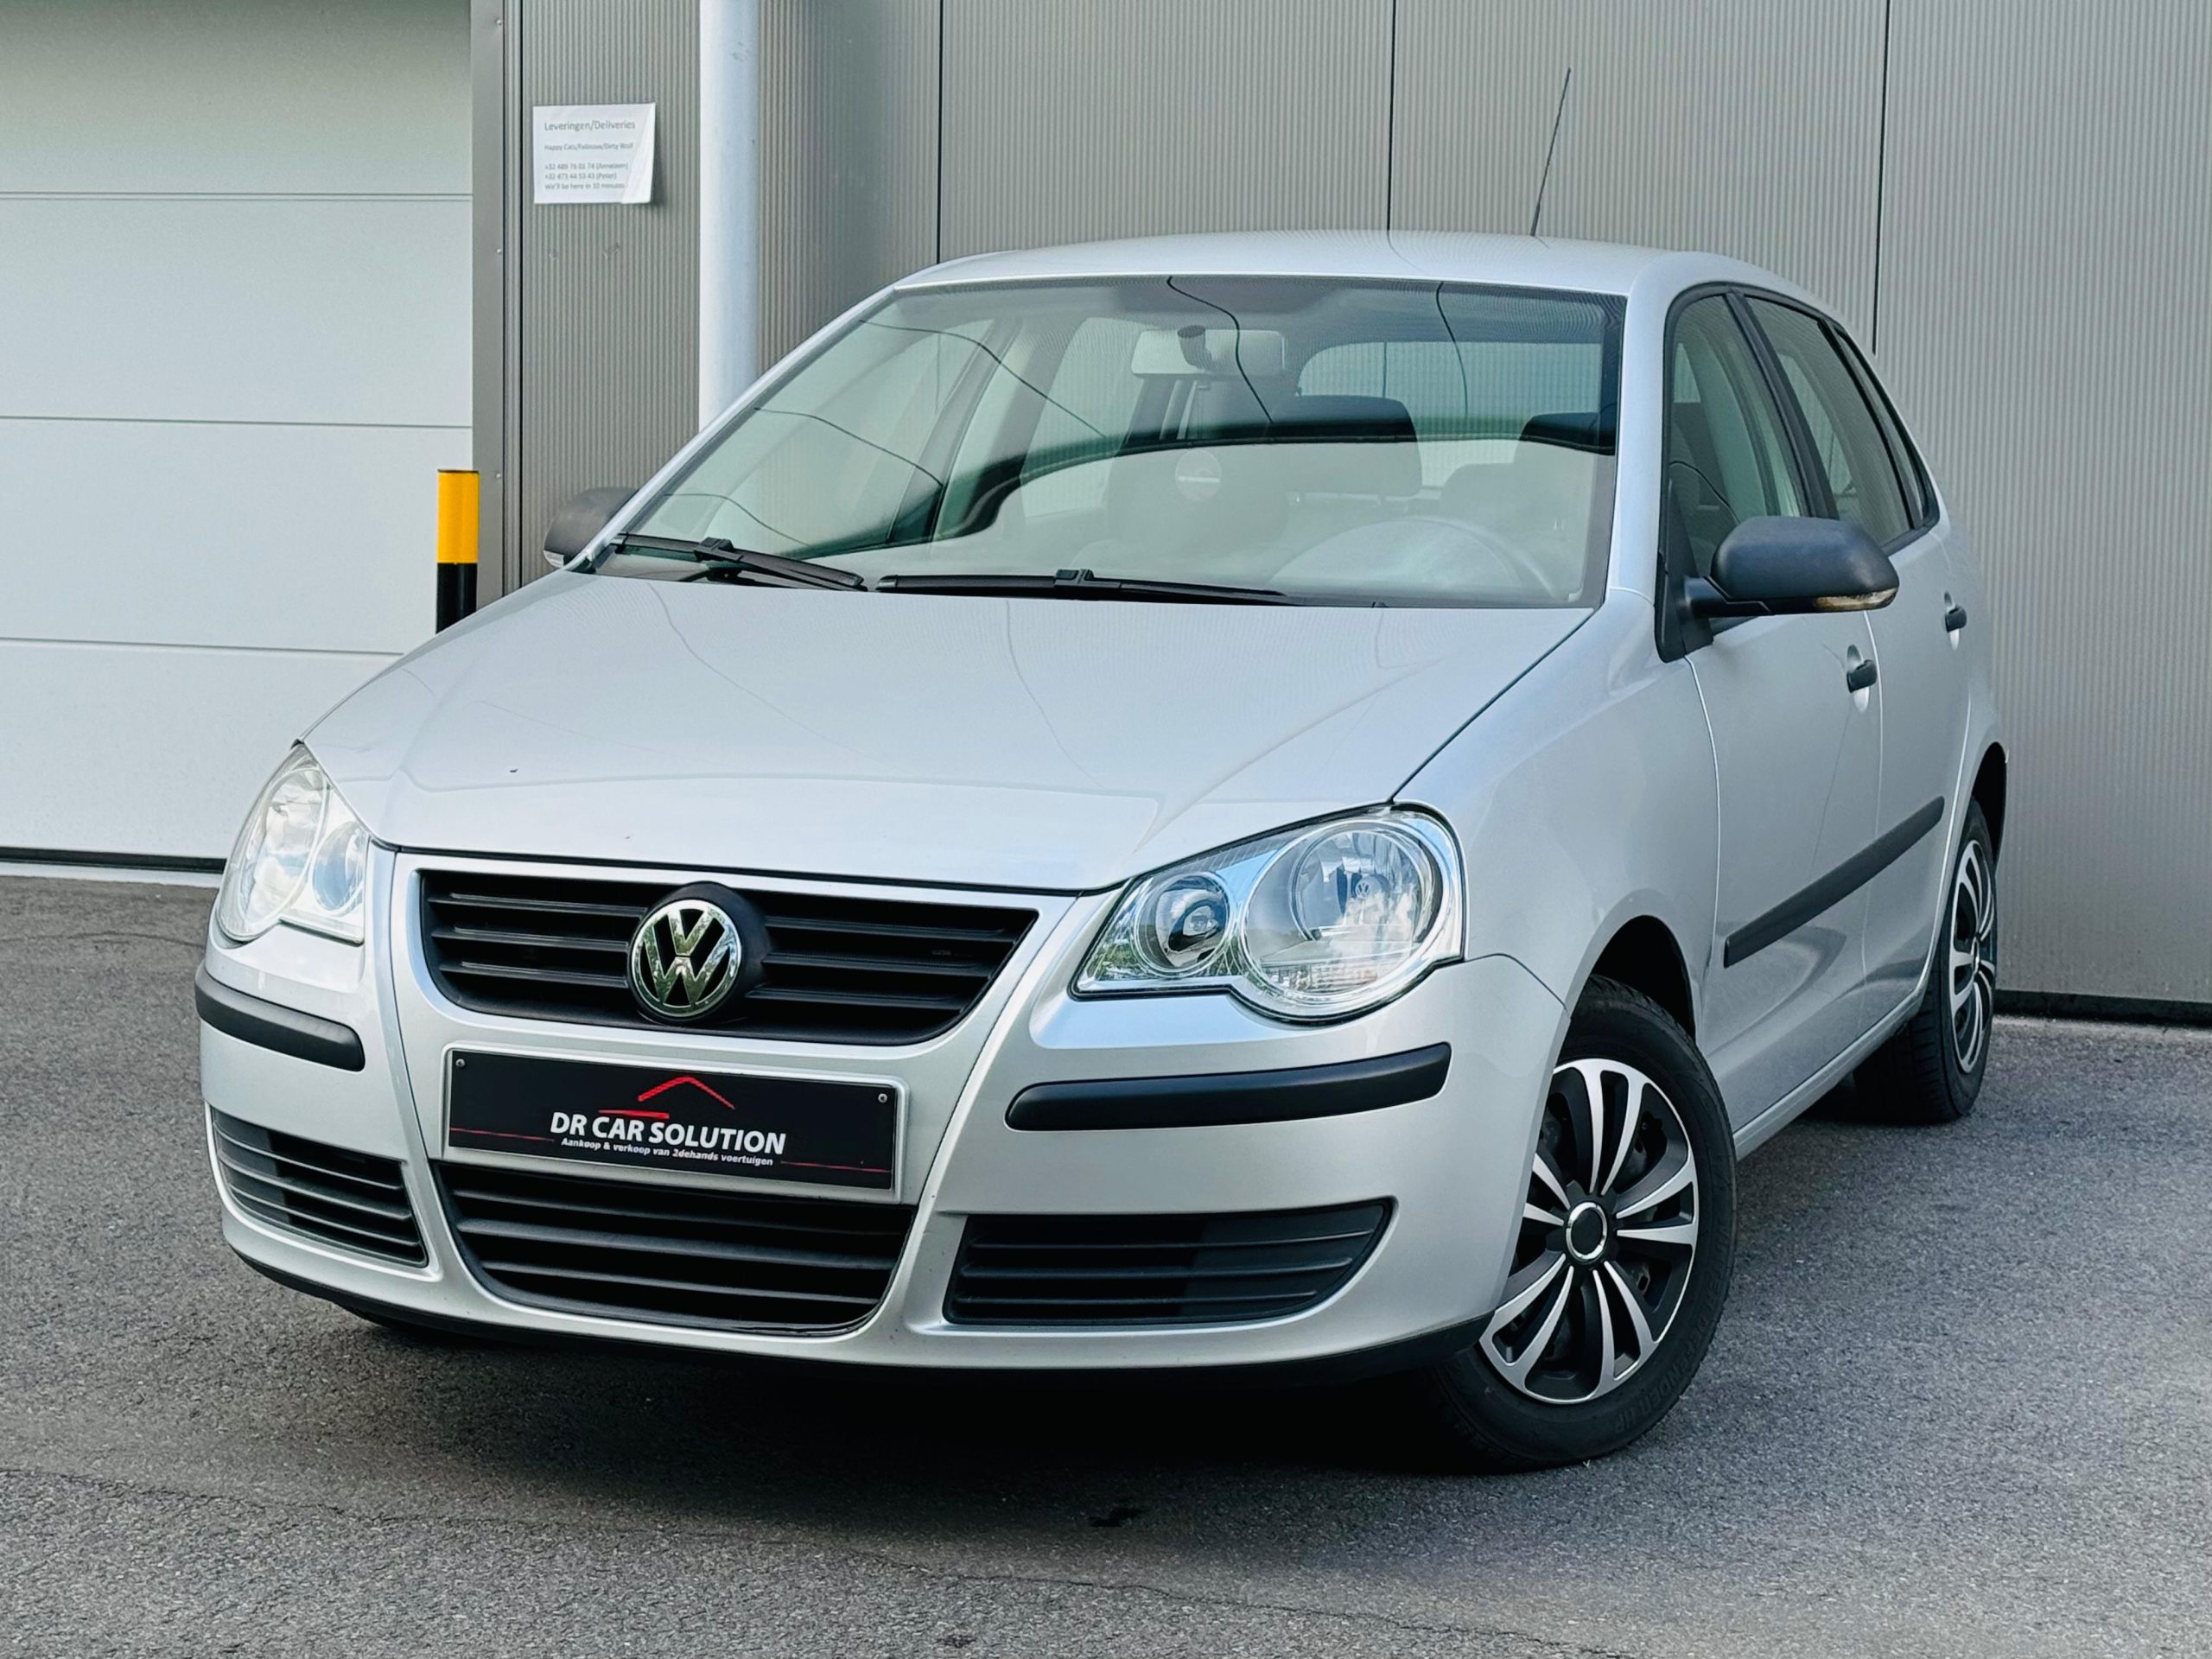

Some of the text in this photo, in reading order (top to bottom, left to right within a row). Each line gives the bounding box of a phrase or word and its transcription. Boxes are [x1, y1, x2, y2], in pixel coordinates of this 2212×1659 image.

[544, 120, 635, 131] Leveringen/Deliveries
[550, 1112, 786, 1155] DR CAR SOLUTION
[561, 1137, 773, 1166] Aankoop & verkoop van 2dehands voertuigen
